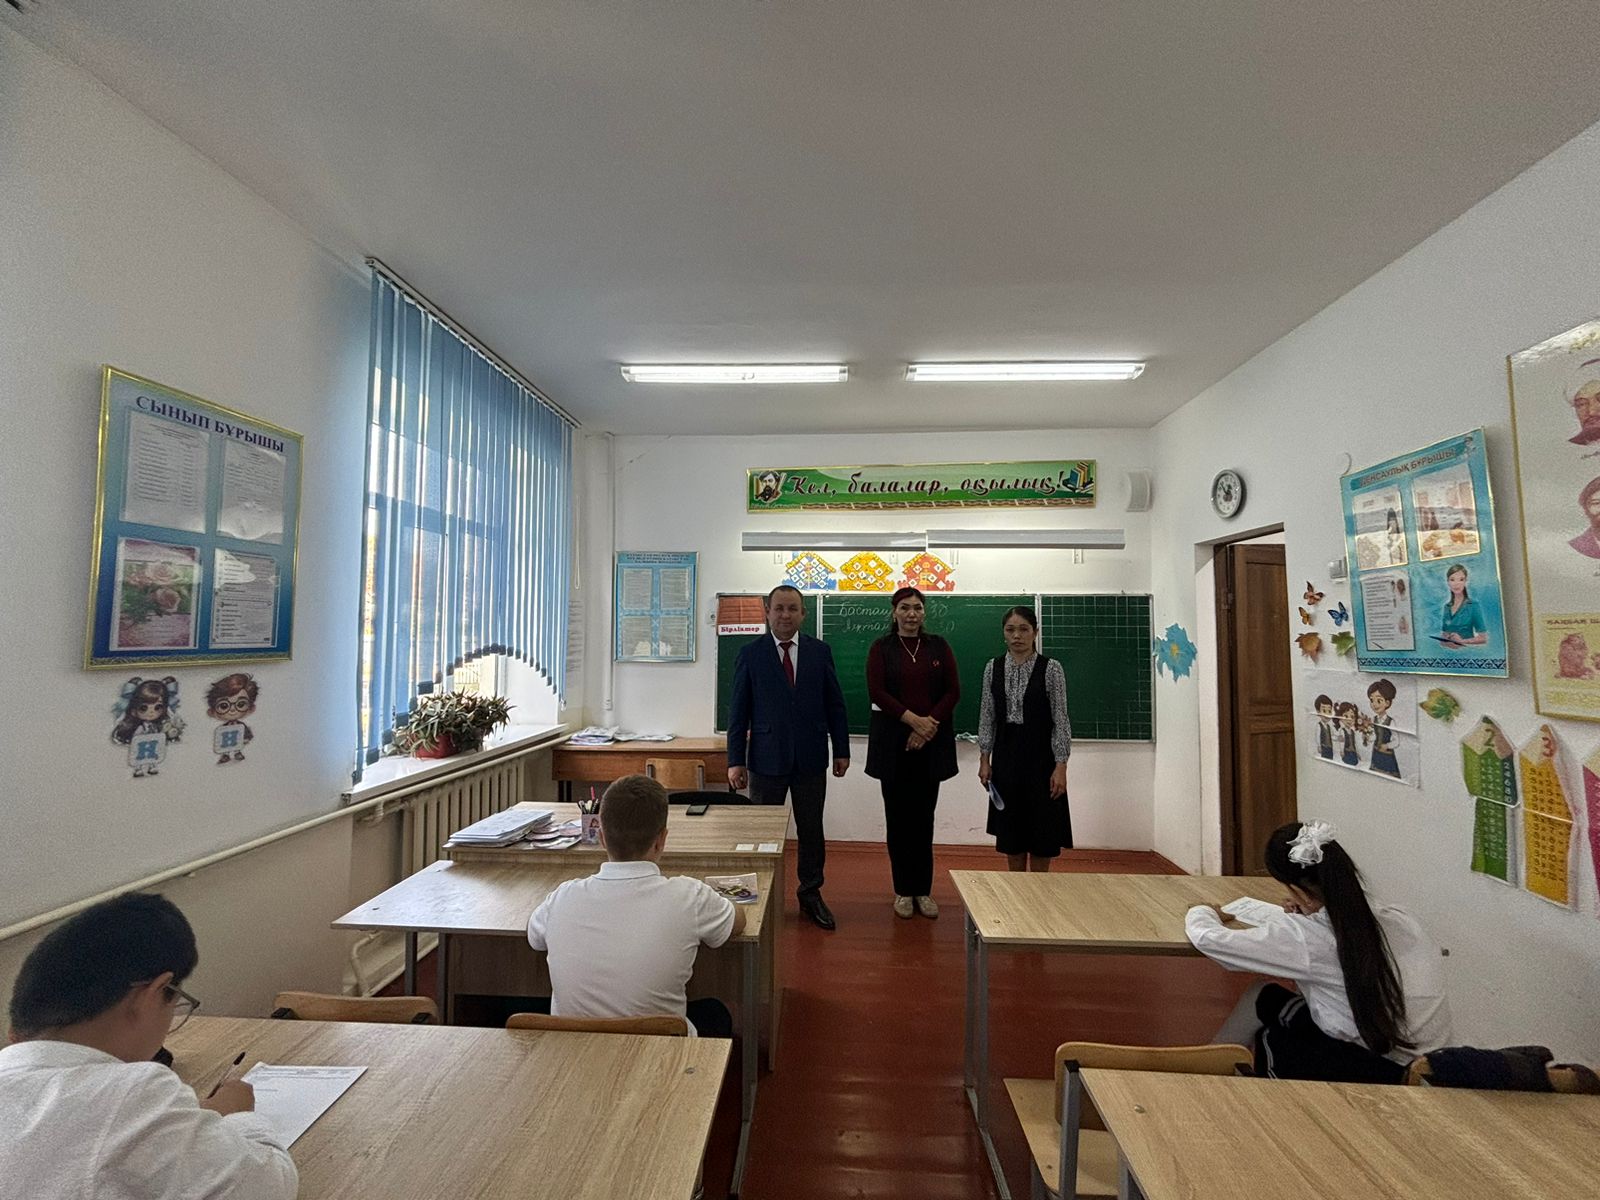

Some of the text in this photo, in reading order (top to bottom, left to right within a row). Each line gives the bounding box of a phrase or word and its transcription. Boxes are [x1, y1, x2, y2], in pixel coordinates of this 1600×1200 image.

[136, 396, 284, 453] СЫНЫП БҰРЫШЫ
[789, 471, 1064, 497] Кел, балалар, оқылық!
[1360, 464, 1410, 487] ДЕНСАУЛЫҚ
[1484, 728, 1495, 747] 2
[1541, 736, 1554, 757] 3
